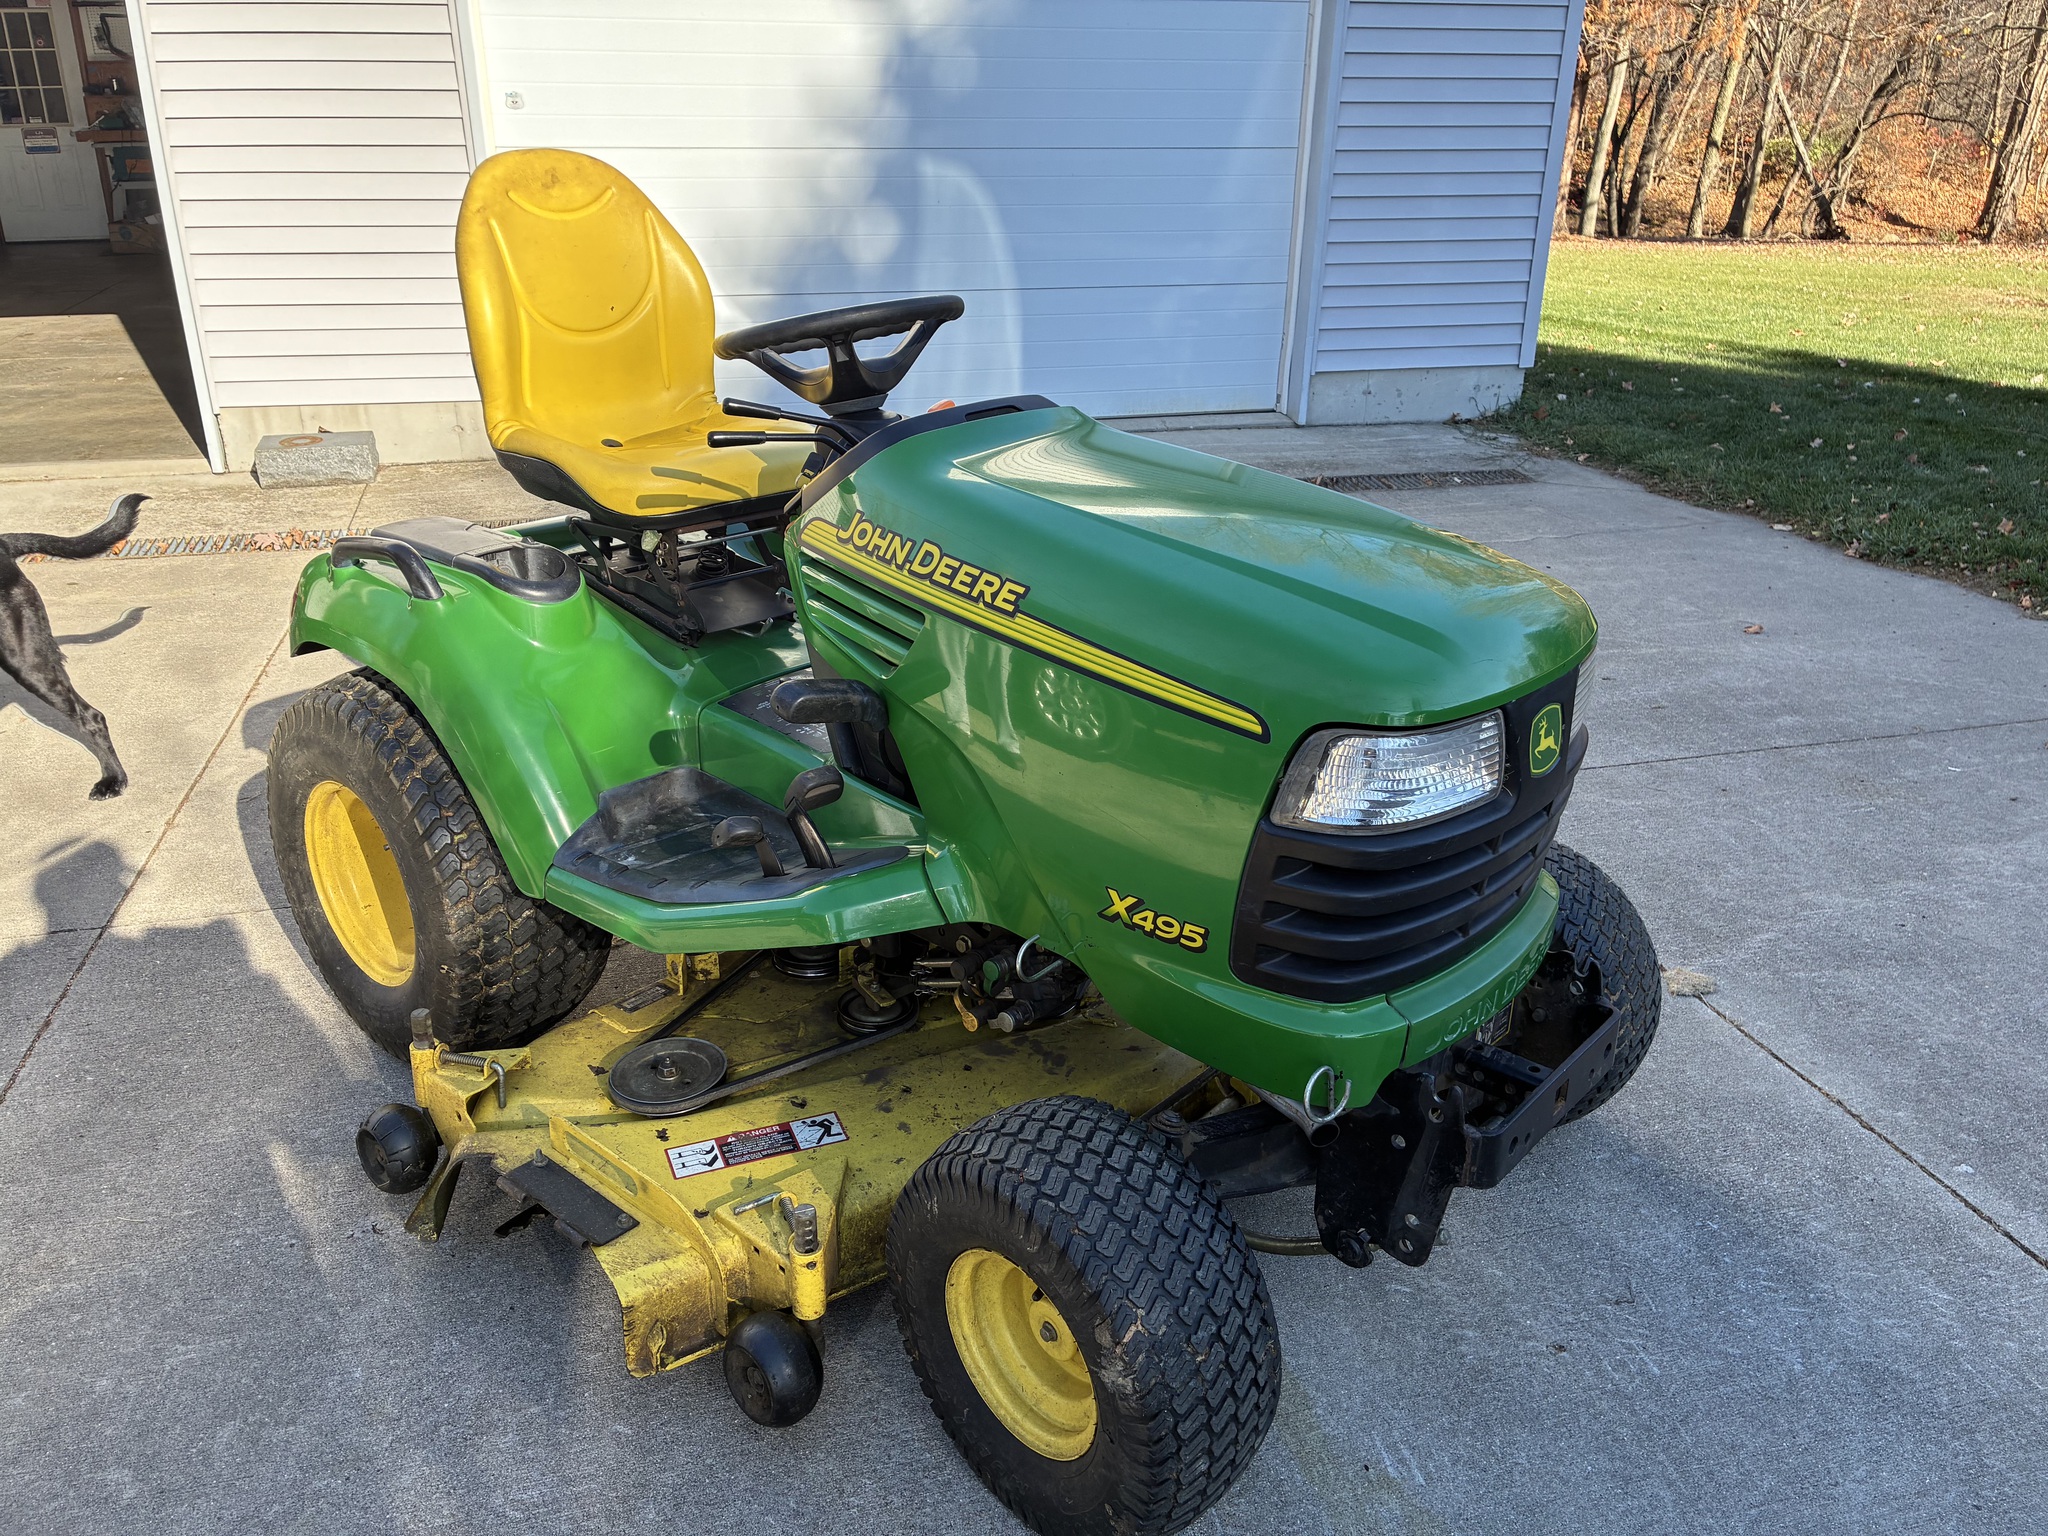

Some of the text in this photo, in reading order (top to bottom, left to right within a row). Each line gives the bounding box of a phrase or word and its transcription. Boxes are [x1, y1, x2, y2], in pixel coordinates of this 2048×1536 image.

[837, 509, 1029, 616] JOHN DEERE
[1099, 886, 1208, 951] X495
[1424, 989, 1500, 1054] JOHN
